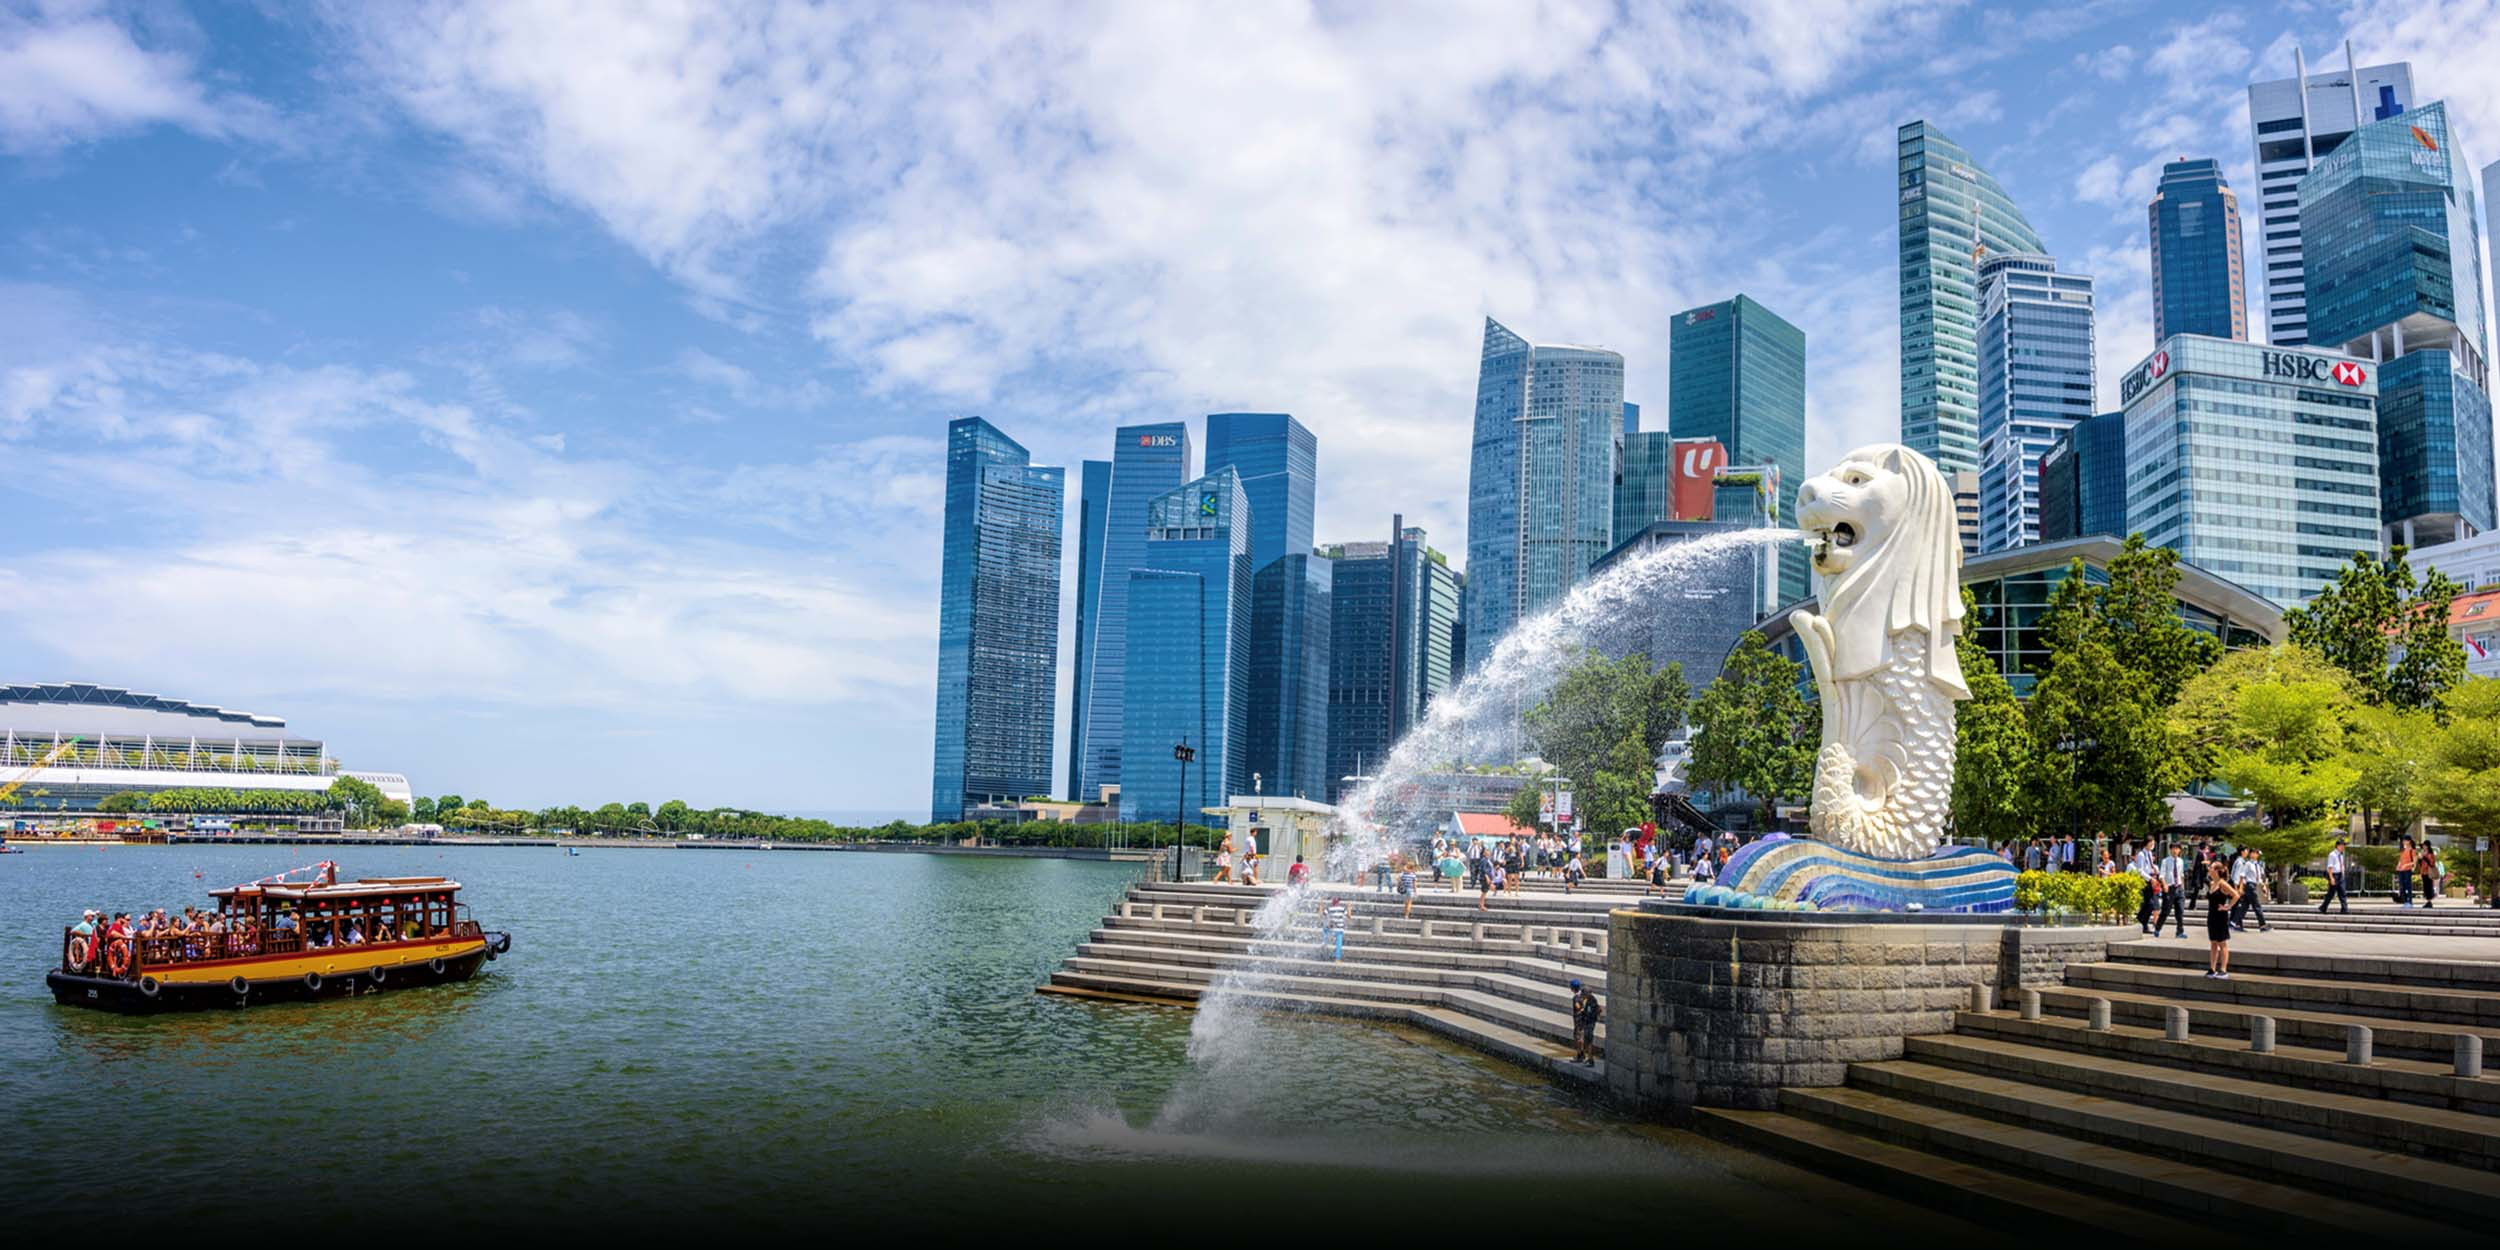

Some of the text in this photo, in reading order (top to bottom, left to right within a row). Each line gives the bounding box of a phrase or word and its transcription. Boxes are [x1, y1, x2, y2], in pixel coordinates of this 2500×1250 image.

[2262, 351, 2329, 382] HSBC
[2121, 363, 2151, 403] HSBC
[1151, 434, 1176, 447] DBS
